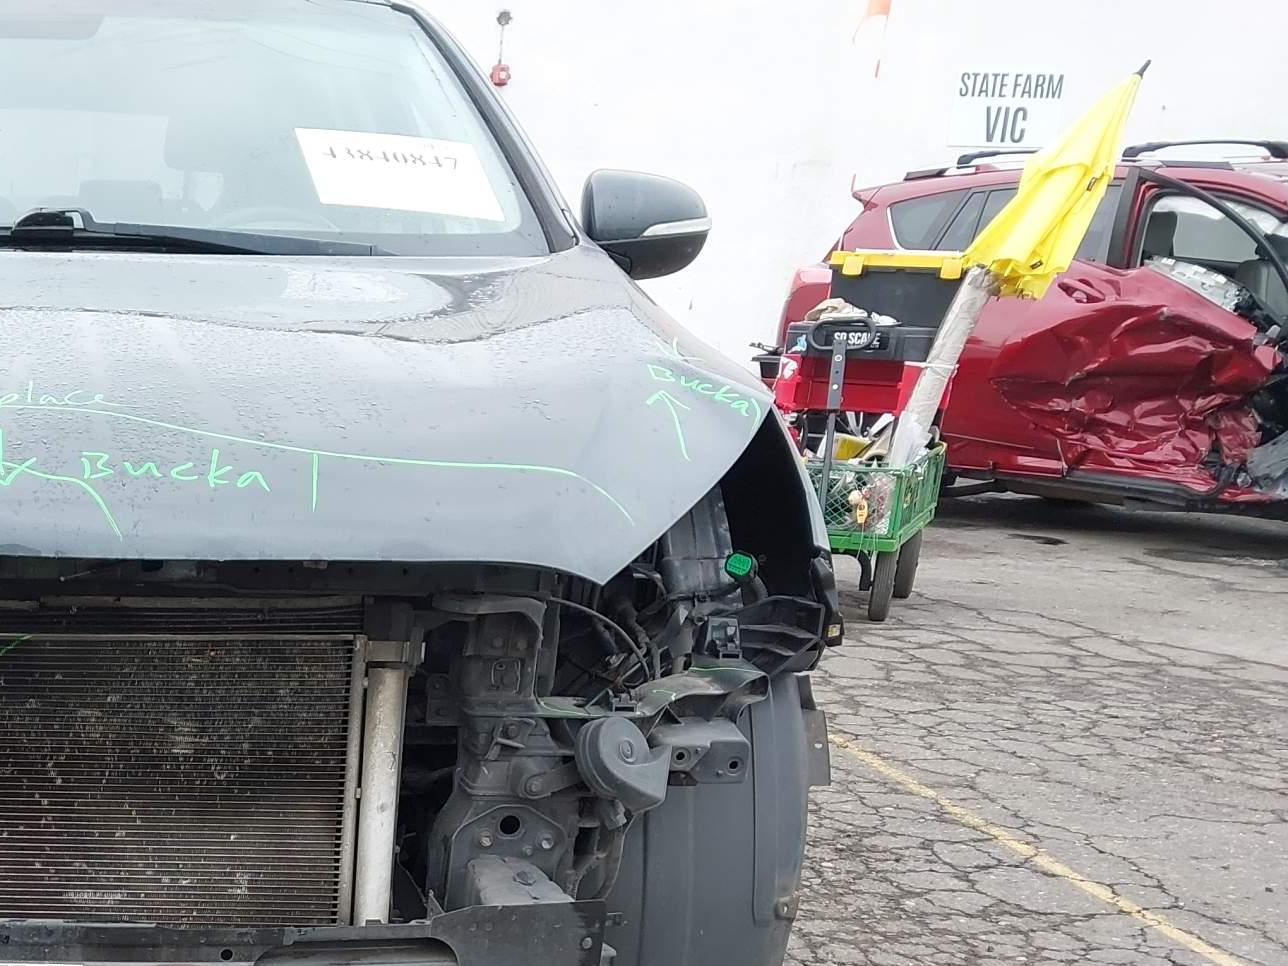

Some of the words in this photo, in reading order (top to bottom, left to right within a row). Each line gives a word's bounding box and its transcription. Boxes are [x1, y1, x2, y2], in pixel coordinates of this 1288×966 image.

[959, 72, 1009, 98] STATE
[1012, 73, 1064, 99] FARM
[986, 106, 1028, 143] VIC
